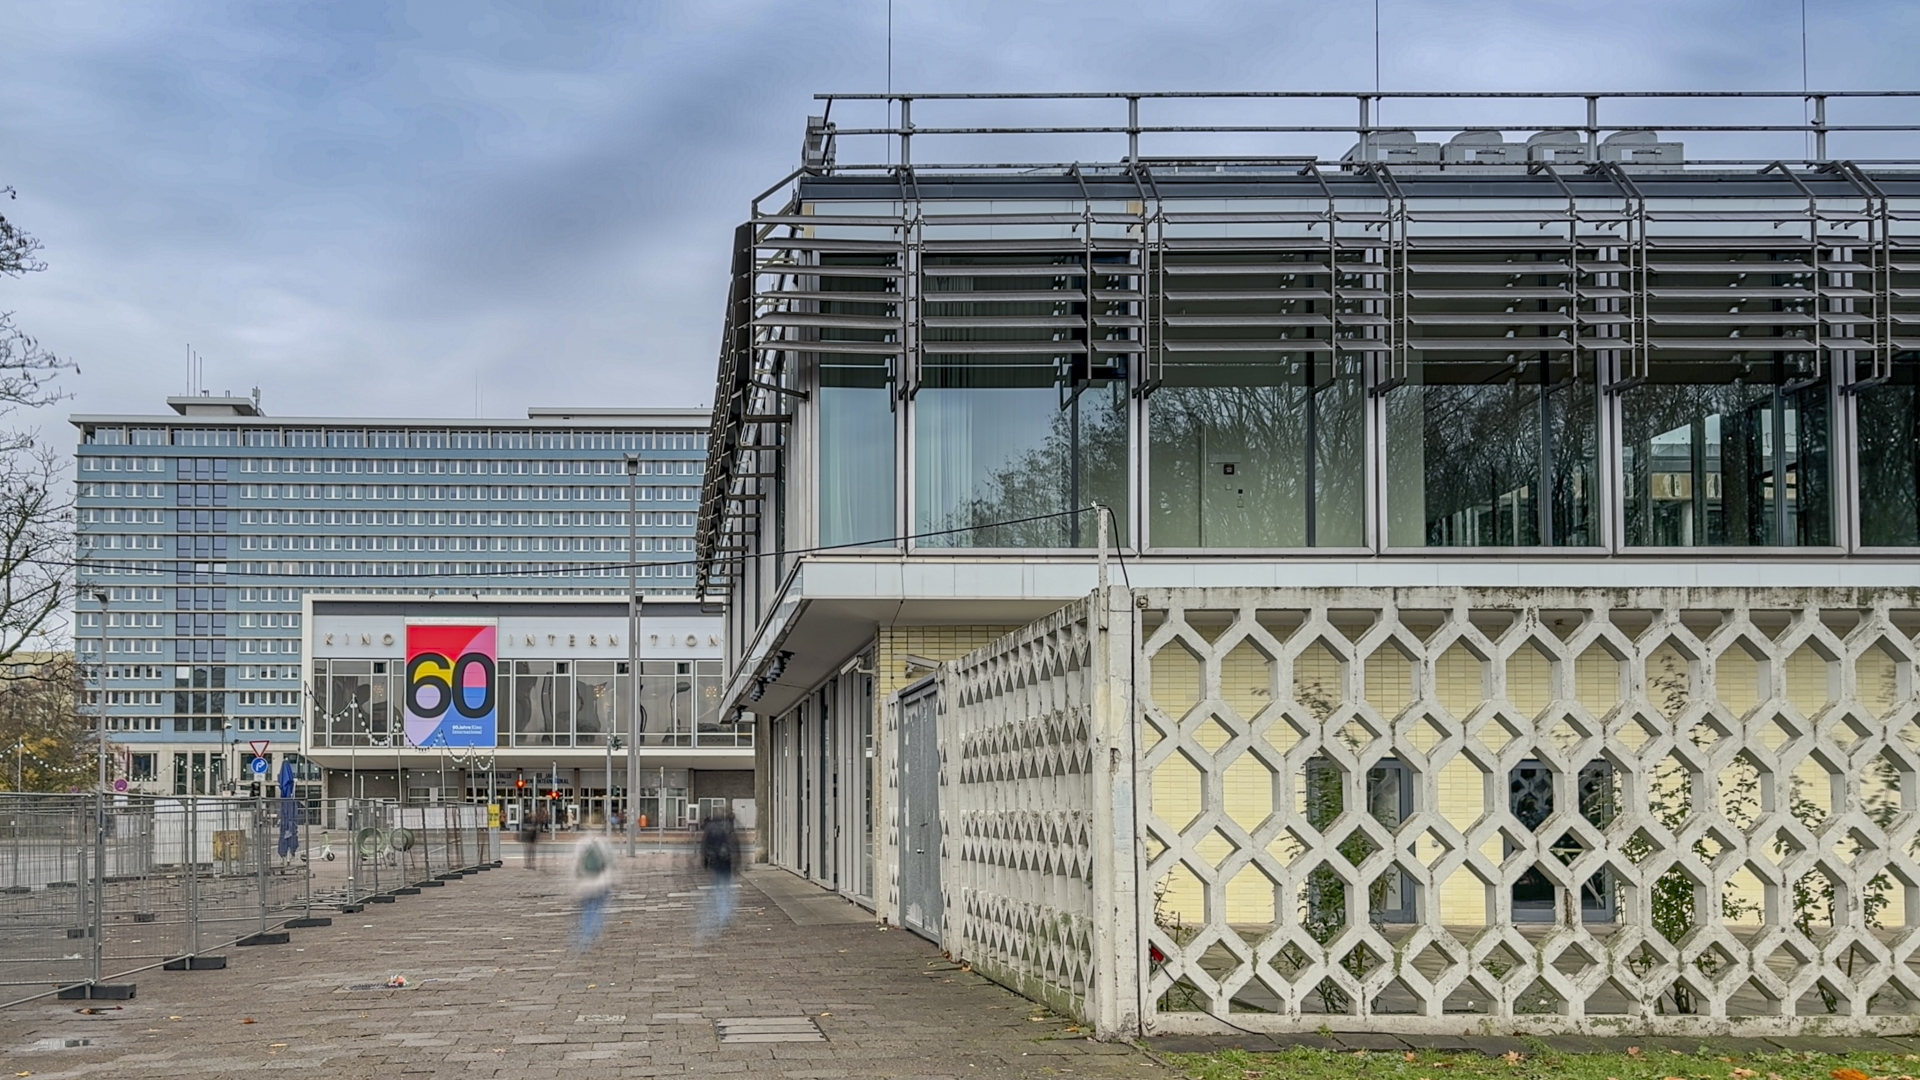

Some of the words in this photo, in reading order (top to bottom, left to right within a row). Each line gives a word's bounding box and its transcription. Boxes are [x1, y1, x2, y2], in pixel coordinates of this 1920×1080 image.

[324, 632, 394, 647] KINO
[508, 632, 718, 648] INTERNTION
[406, 651, 496, 719] 60
